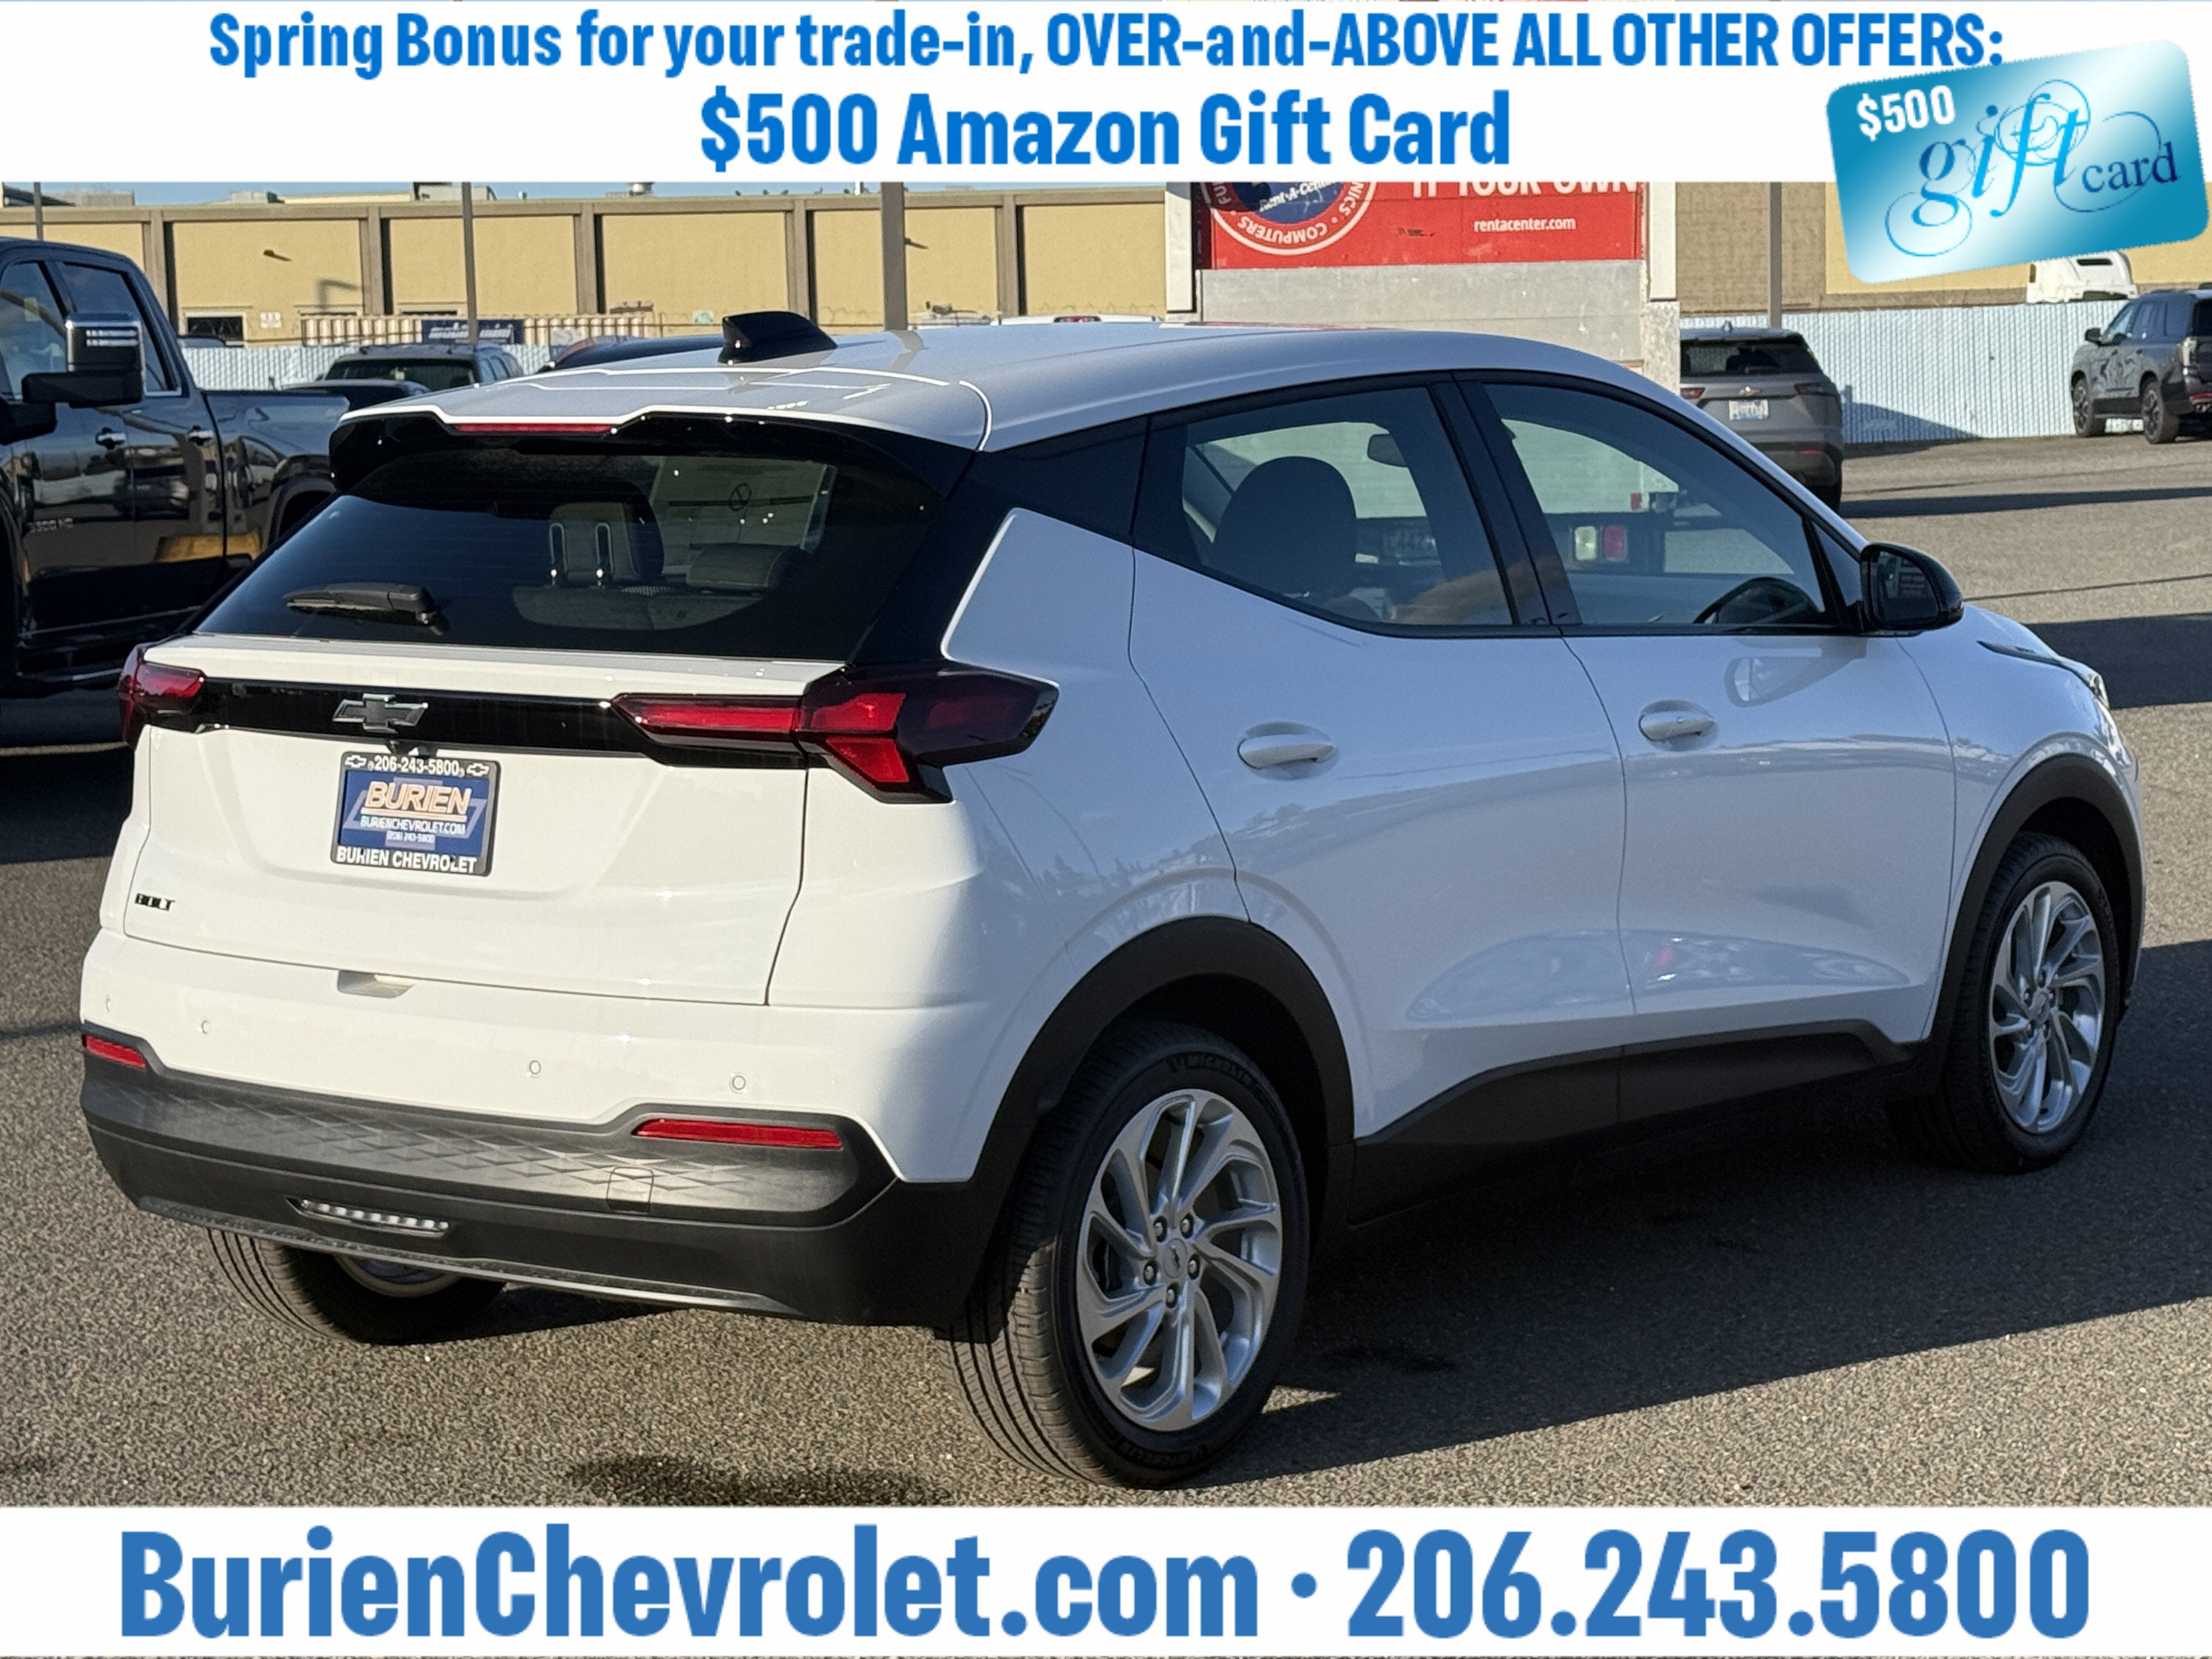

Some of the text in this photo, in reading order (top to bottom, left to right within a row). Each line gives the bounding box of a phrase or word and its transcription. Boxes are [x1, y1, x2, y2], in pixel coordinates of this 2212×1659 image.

[1237, 216, 1328, 245] COMPUTERS
[1473, 218, 1577, 233] rentacenter.com
[374, 755, 460, 776] 206-243-5800
[364, 781, 472, 815] BURIEN
[336, 846, 477, 873] BURIEN CHEVROLET
[135, 893, 176, 911] BOLT
